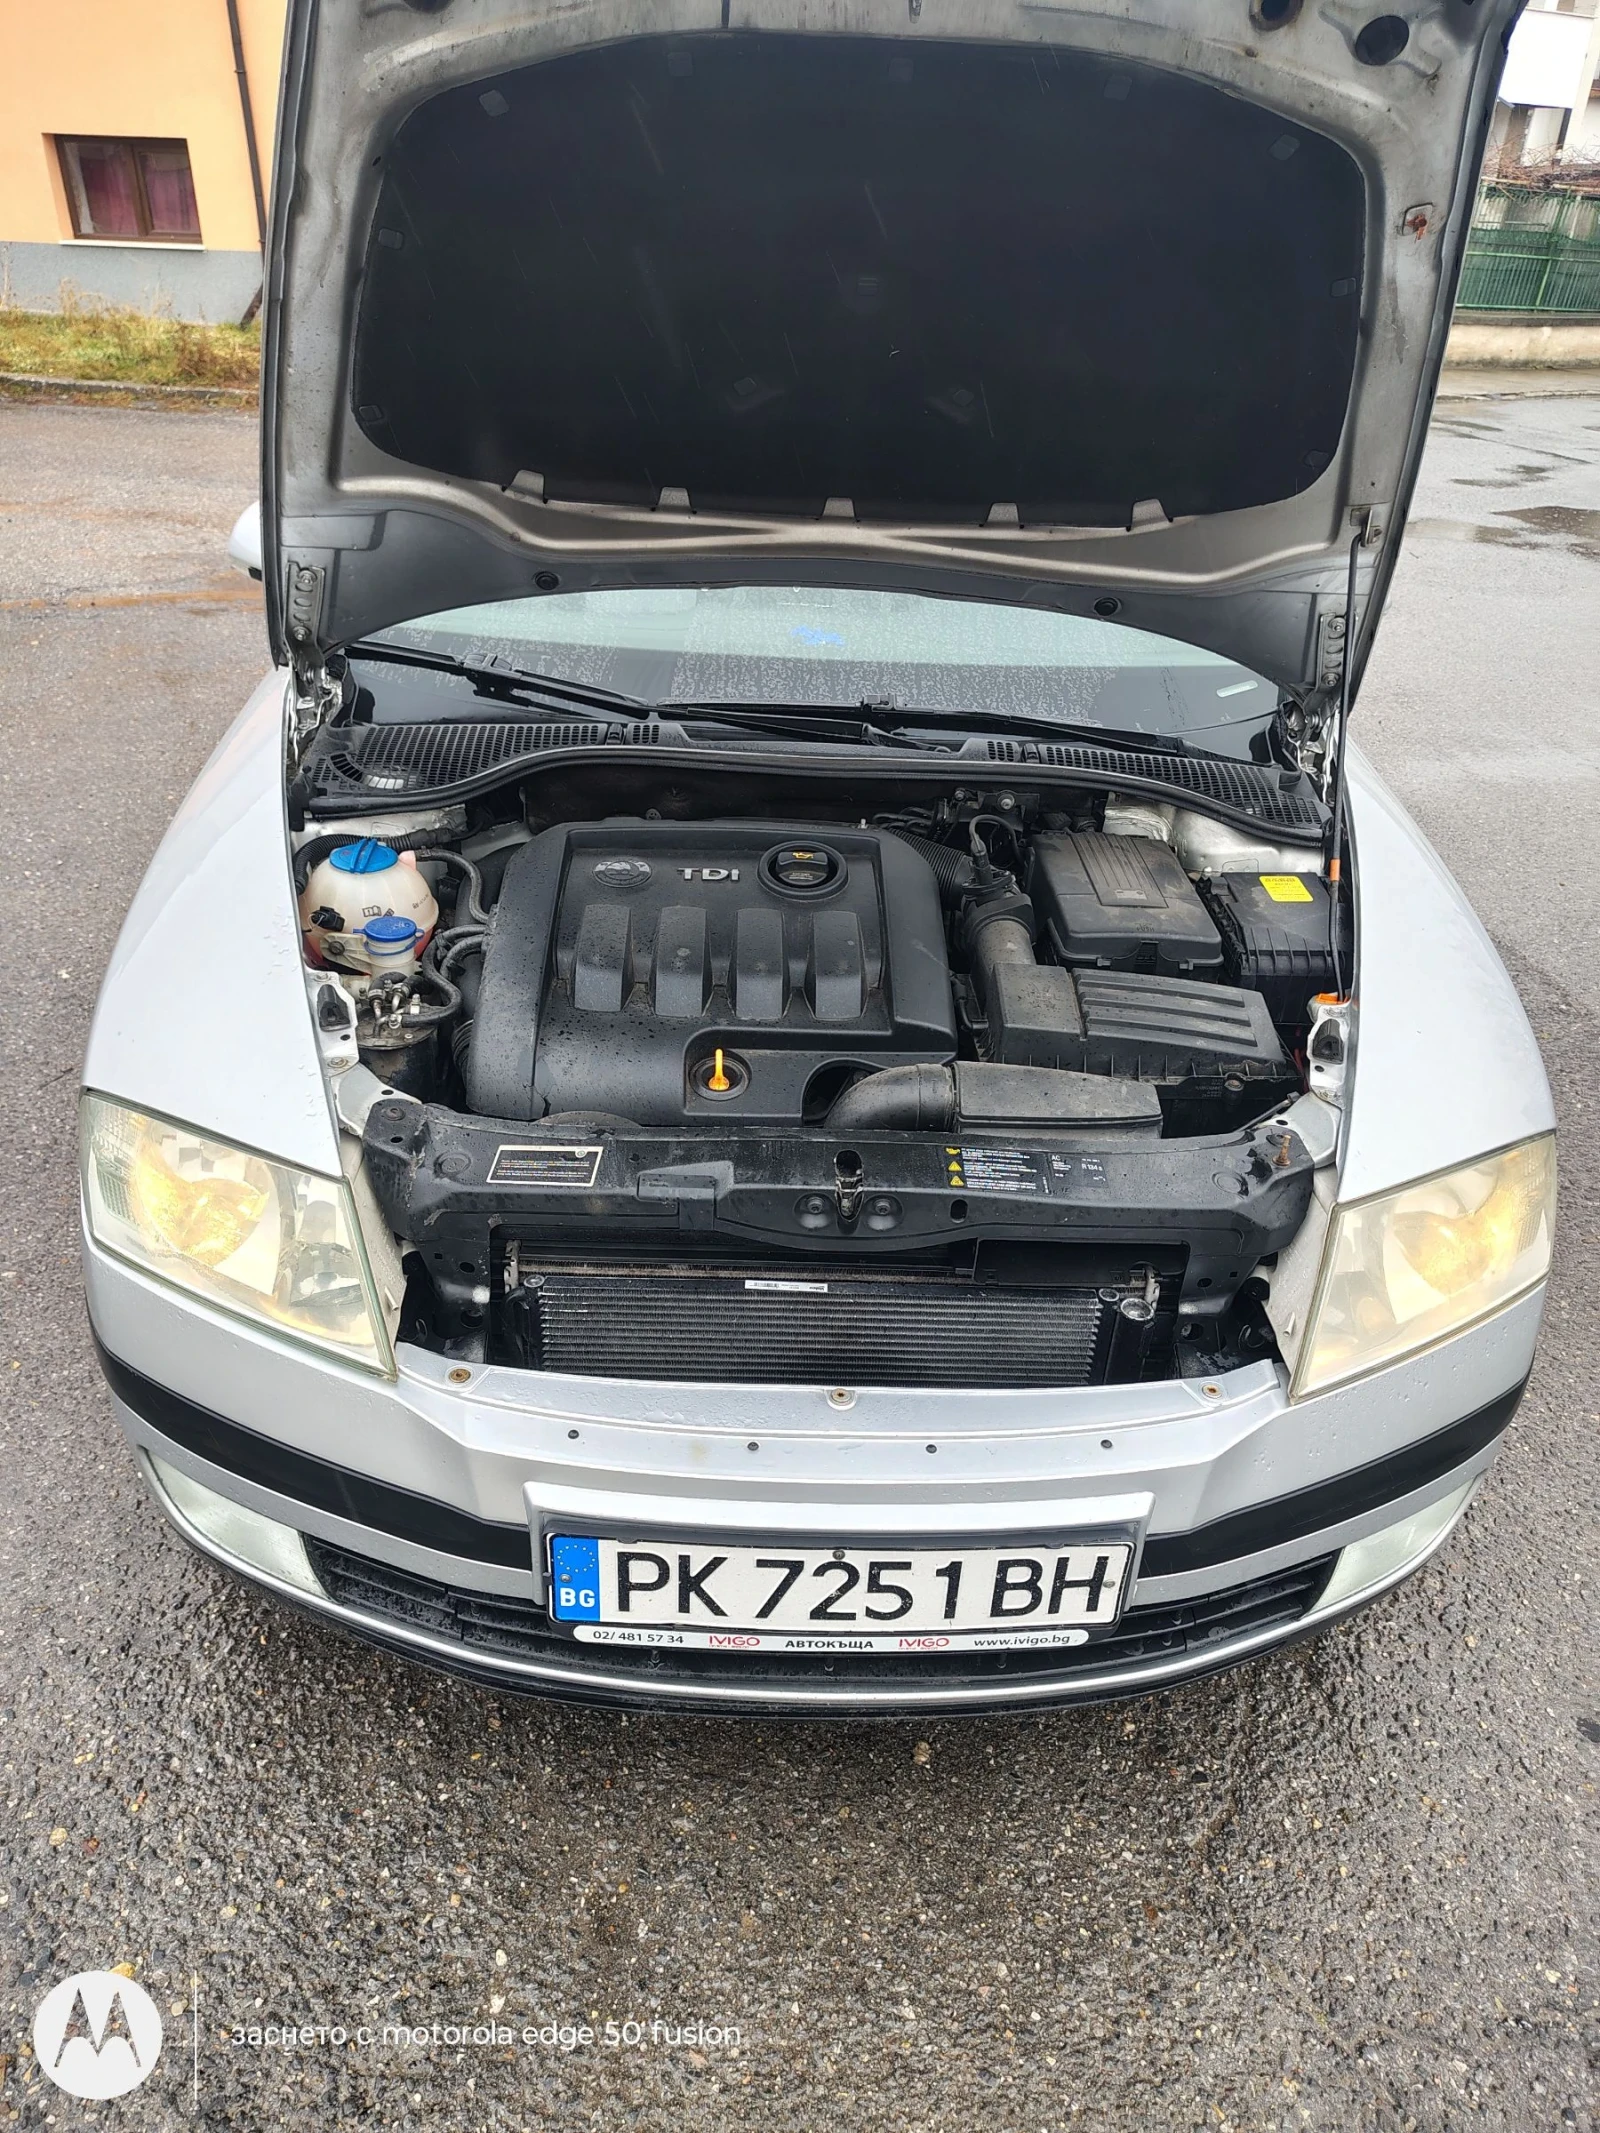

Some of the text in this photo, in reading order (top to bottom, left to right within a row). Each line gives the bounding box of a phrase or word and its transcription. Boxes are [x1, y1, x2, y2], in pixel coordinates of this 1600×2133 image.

[616, 1551, 1104, 1620] PK 7251 BH
[560, 1586, 596, 1609] BG
[593, 1630, 684, 1644] 02/ 481 57 34
[709, 1635, 761, 1647] IVIGO
[899, 1638, 950, 1647] IVIGO
[973, 1634, 1070, 1647] www.ivigo.bg
[785, 1640, 874, 1649] АВТОКЪЩА
